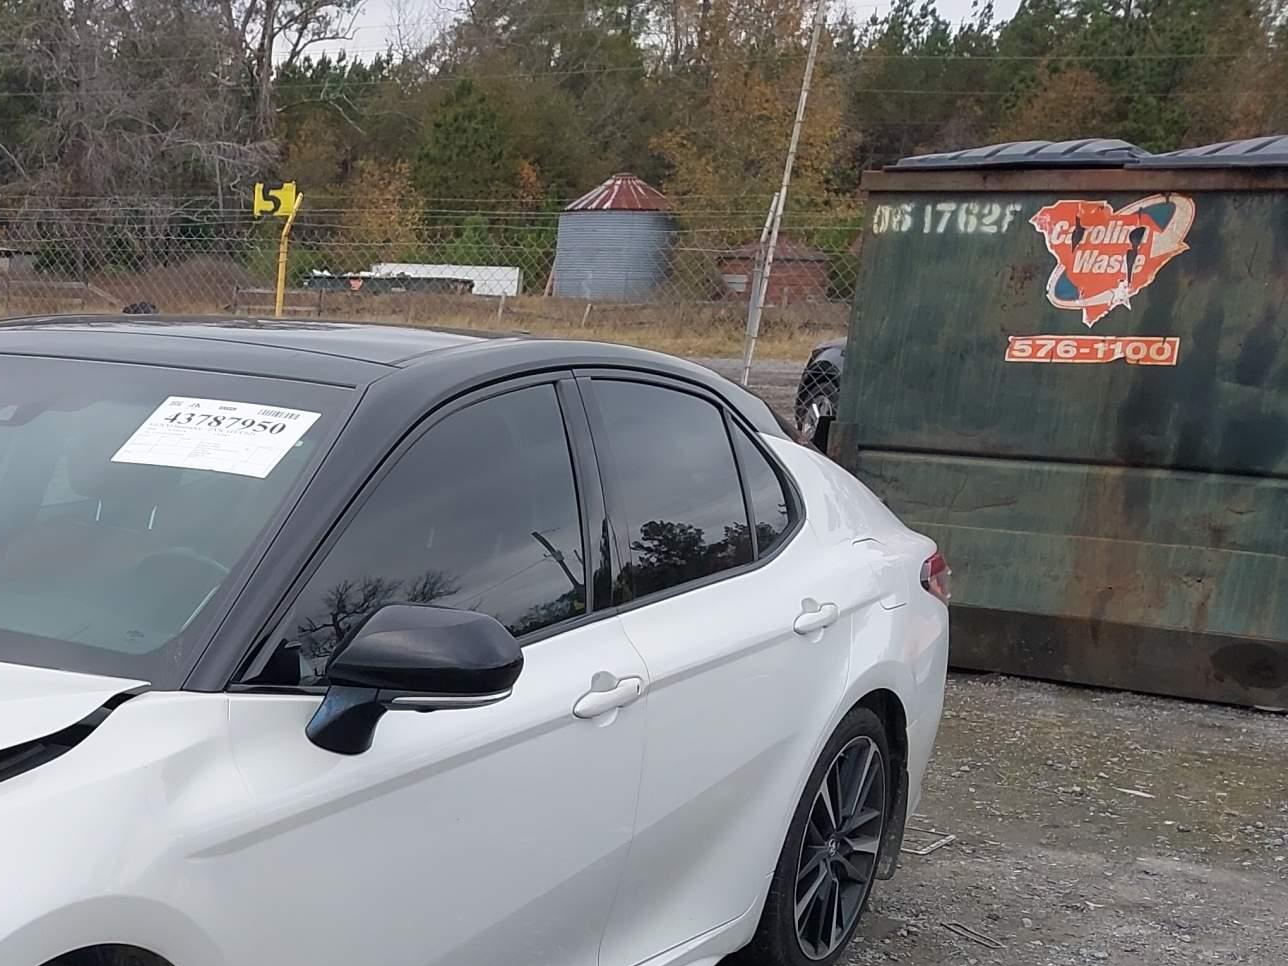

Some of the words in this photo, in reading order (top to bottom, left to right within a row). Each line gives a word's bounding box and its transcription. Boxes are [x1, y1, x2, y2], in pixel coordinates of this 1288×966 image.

[259, 183, 284, 216] 5
[1011, 340, 1171, 361] 576-1100
[164, 411, 288, 435] 43787950
